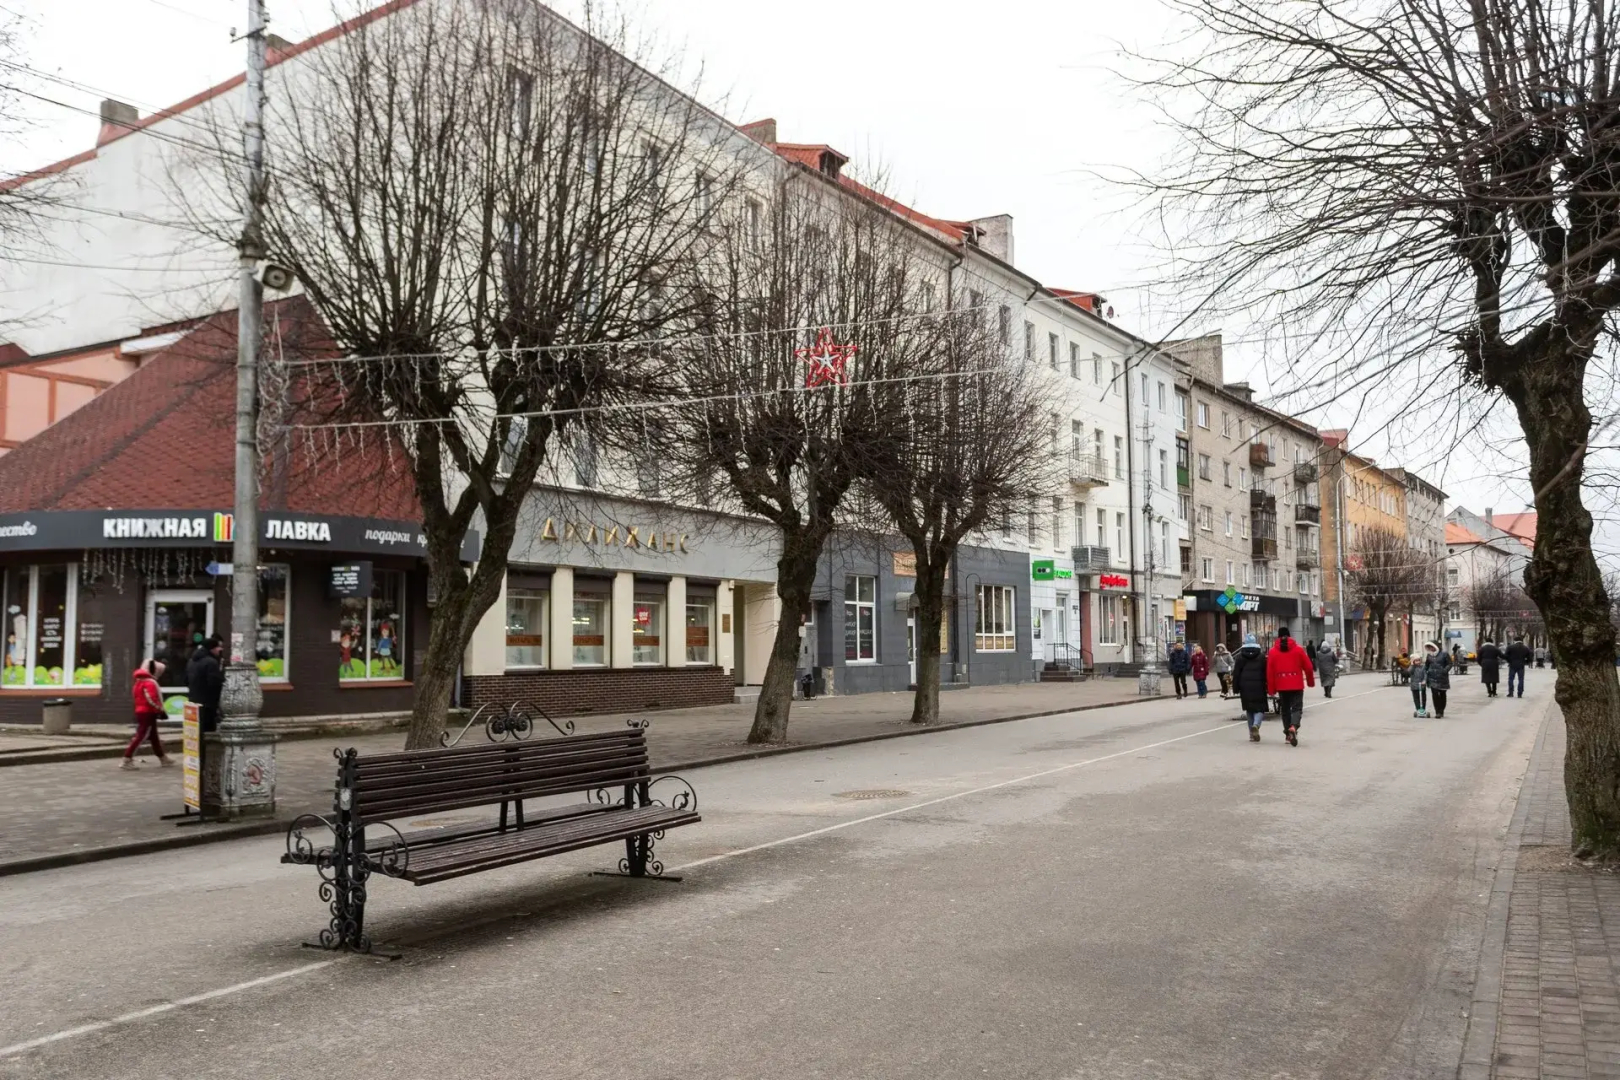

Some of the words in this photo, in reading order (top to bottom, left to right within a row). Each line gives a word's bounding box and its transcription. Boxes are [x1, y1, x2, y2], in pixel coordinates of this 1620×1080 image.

[0, 520, 37, 537] ество
[103, 518, 206, 538] КНИЖНАЯ
[265, 520, 331, 541] ЛАВКА
[364, 529, 411, 545] подарки
